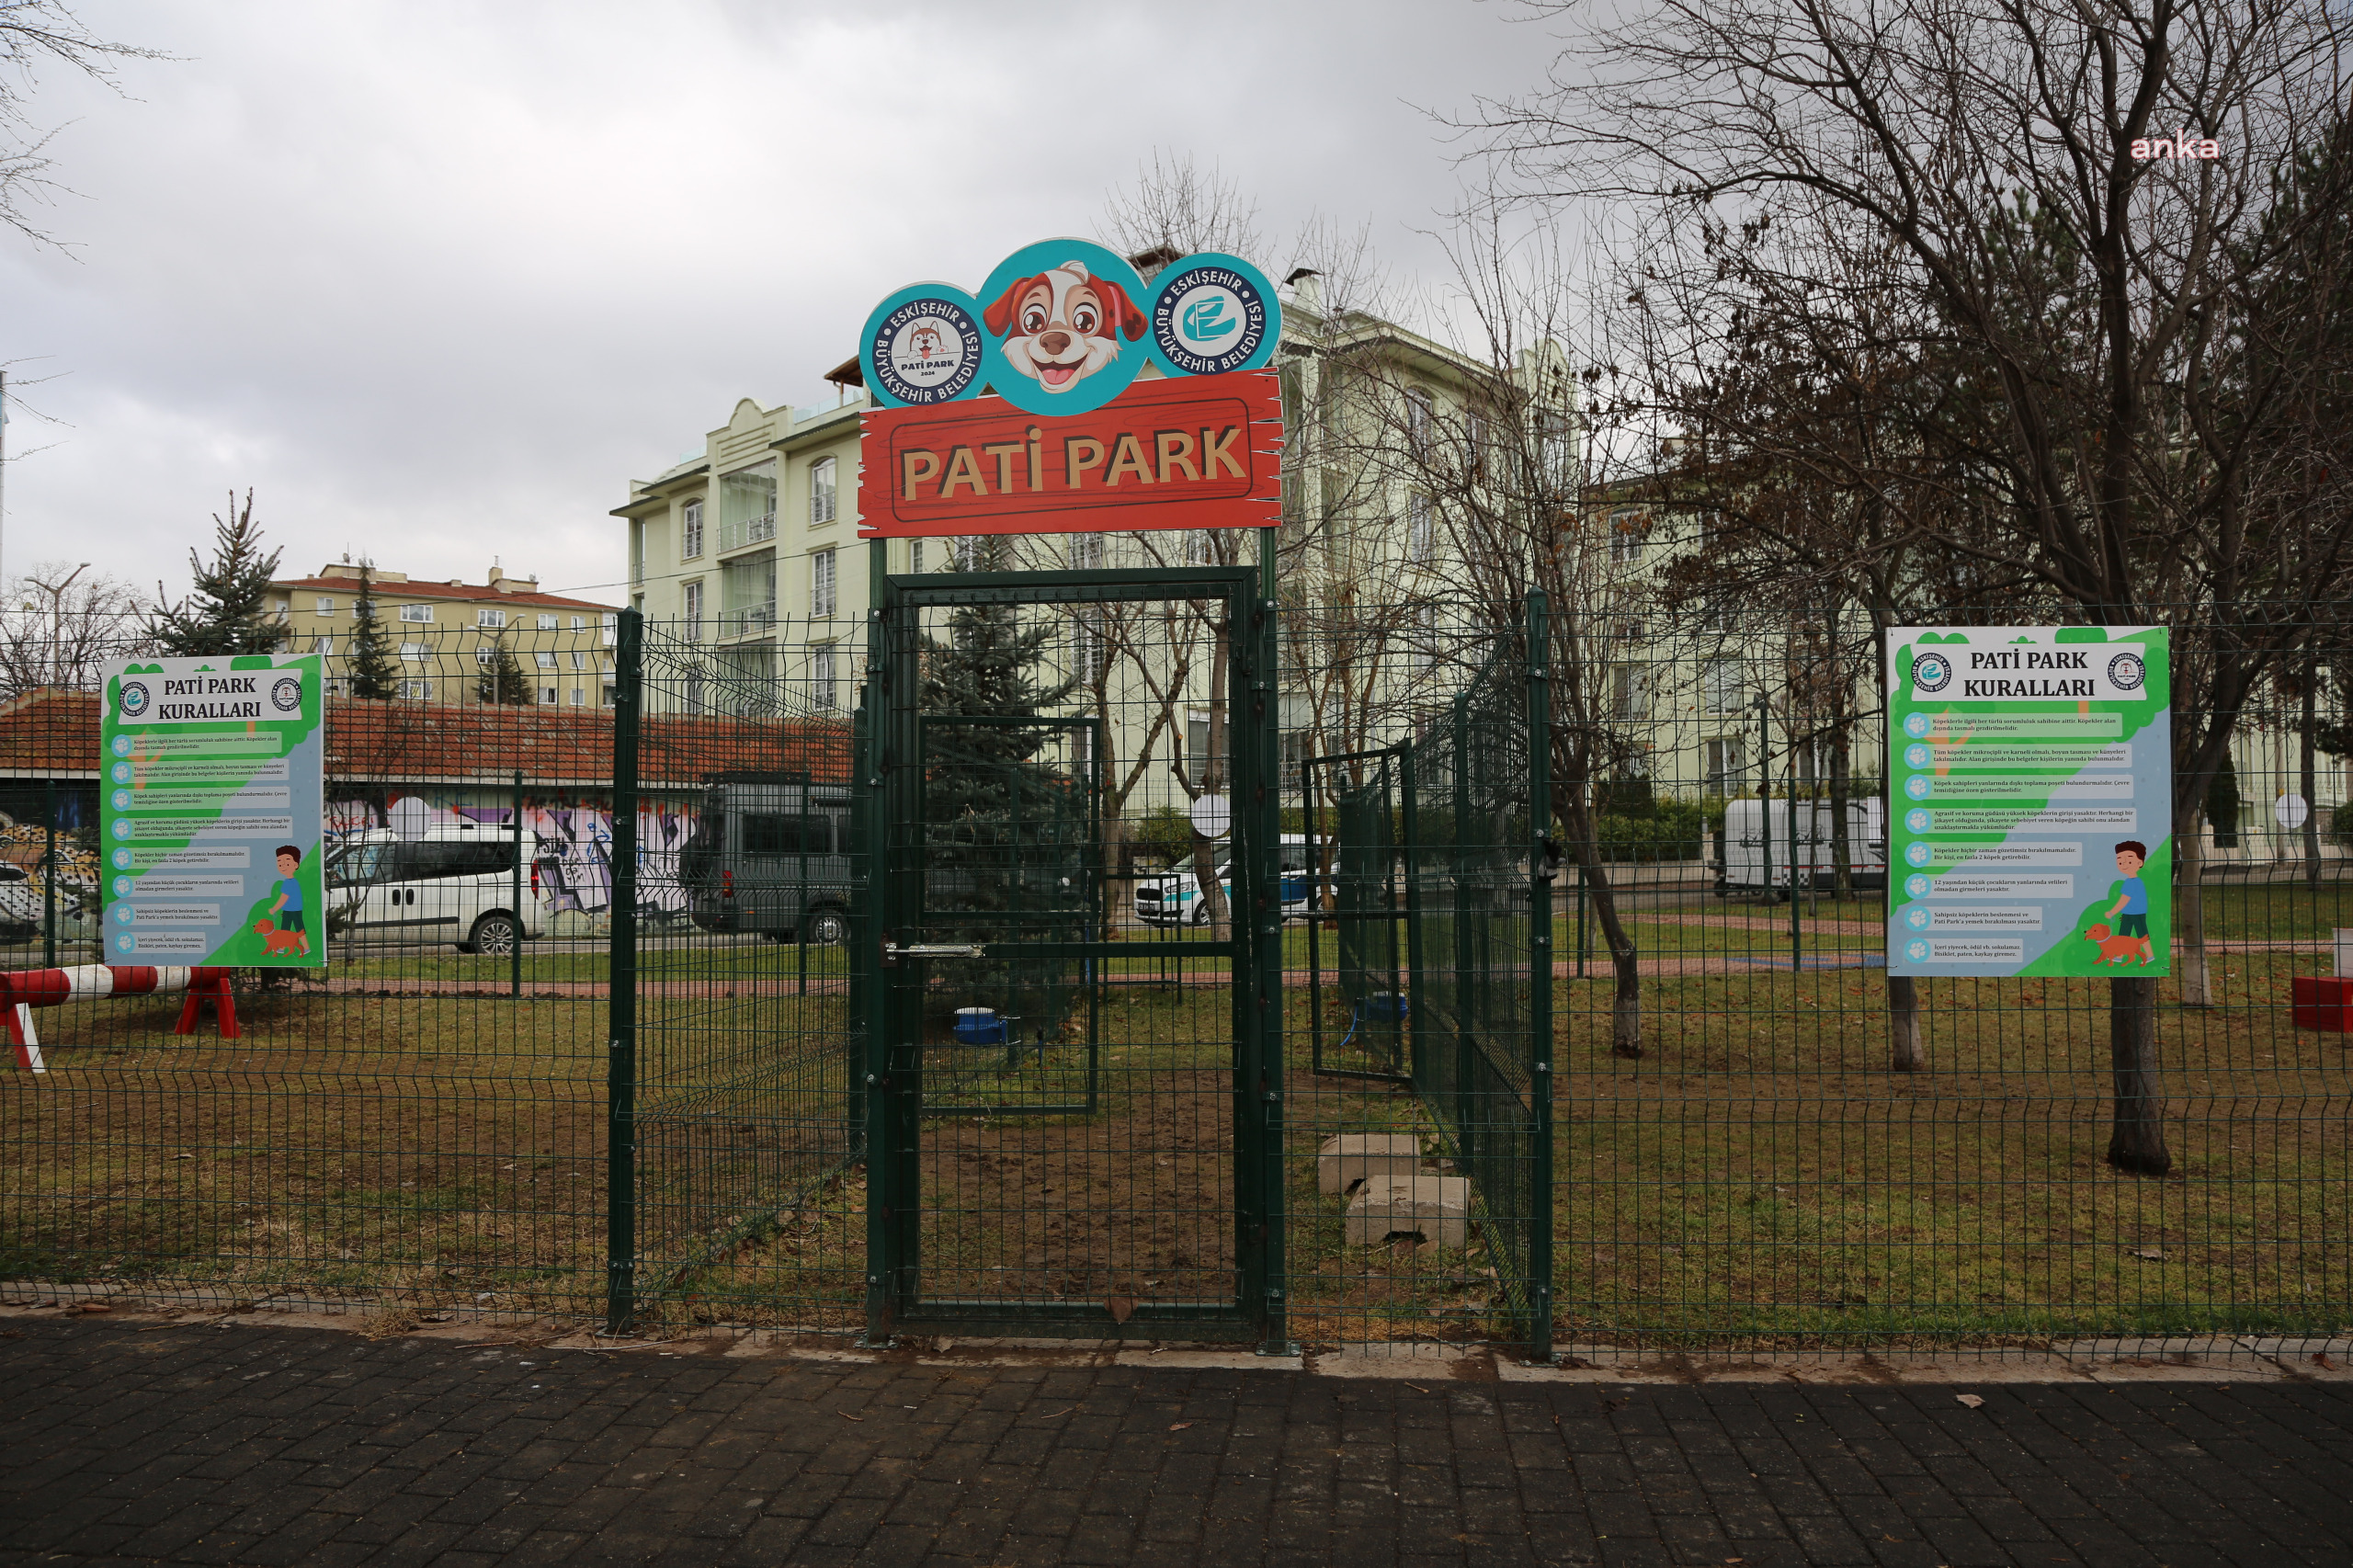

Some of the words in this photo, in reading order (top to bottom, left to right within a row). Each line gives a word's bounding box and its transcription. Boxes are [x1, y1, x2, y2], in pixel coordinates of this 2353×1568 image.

[1170, 270, 1243, 297] ESKİŞEHİR
[889, 301, 961, 329] ESKİŞEHİR
[1156, 307, 1216, 372] BÜYÜKŞEHİR
[1221, 300, 1262, 370] BELEDİYESİ
[877, 340, 933, 403] BÜYÜKŞEHİR
[938, 330, 979, 402] BELEDİYESİ
[901, 360, 924, 371] PATİ
[926, 359, 955, 370] PARK
[900, 426, 1044, 502] PATİ
[1064, 426, 1246, 490] PARK
[1971, 648, 2020, 670] PATİ
[2027, 652, 2088, 669] PARK
[164, 676, 203, 695] PATİ
[208, 677, 256, 693] PARK
[1964, 679, 2095, 697] KURALLARI
[159, 702, 261, 720] KURALLARI
